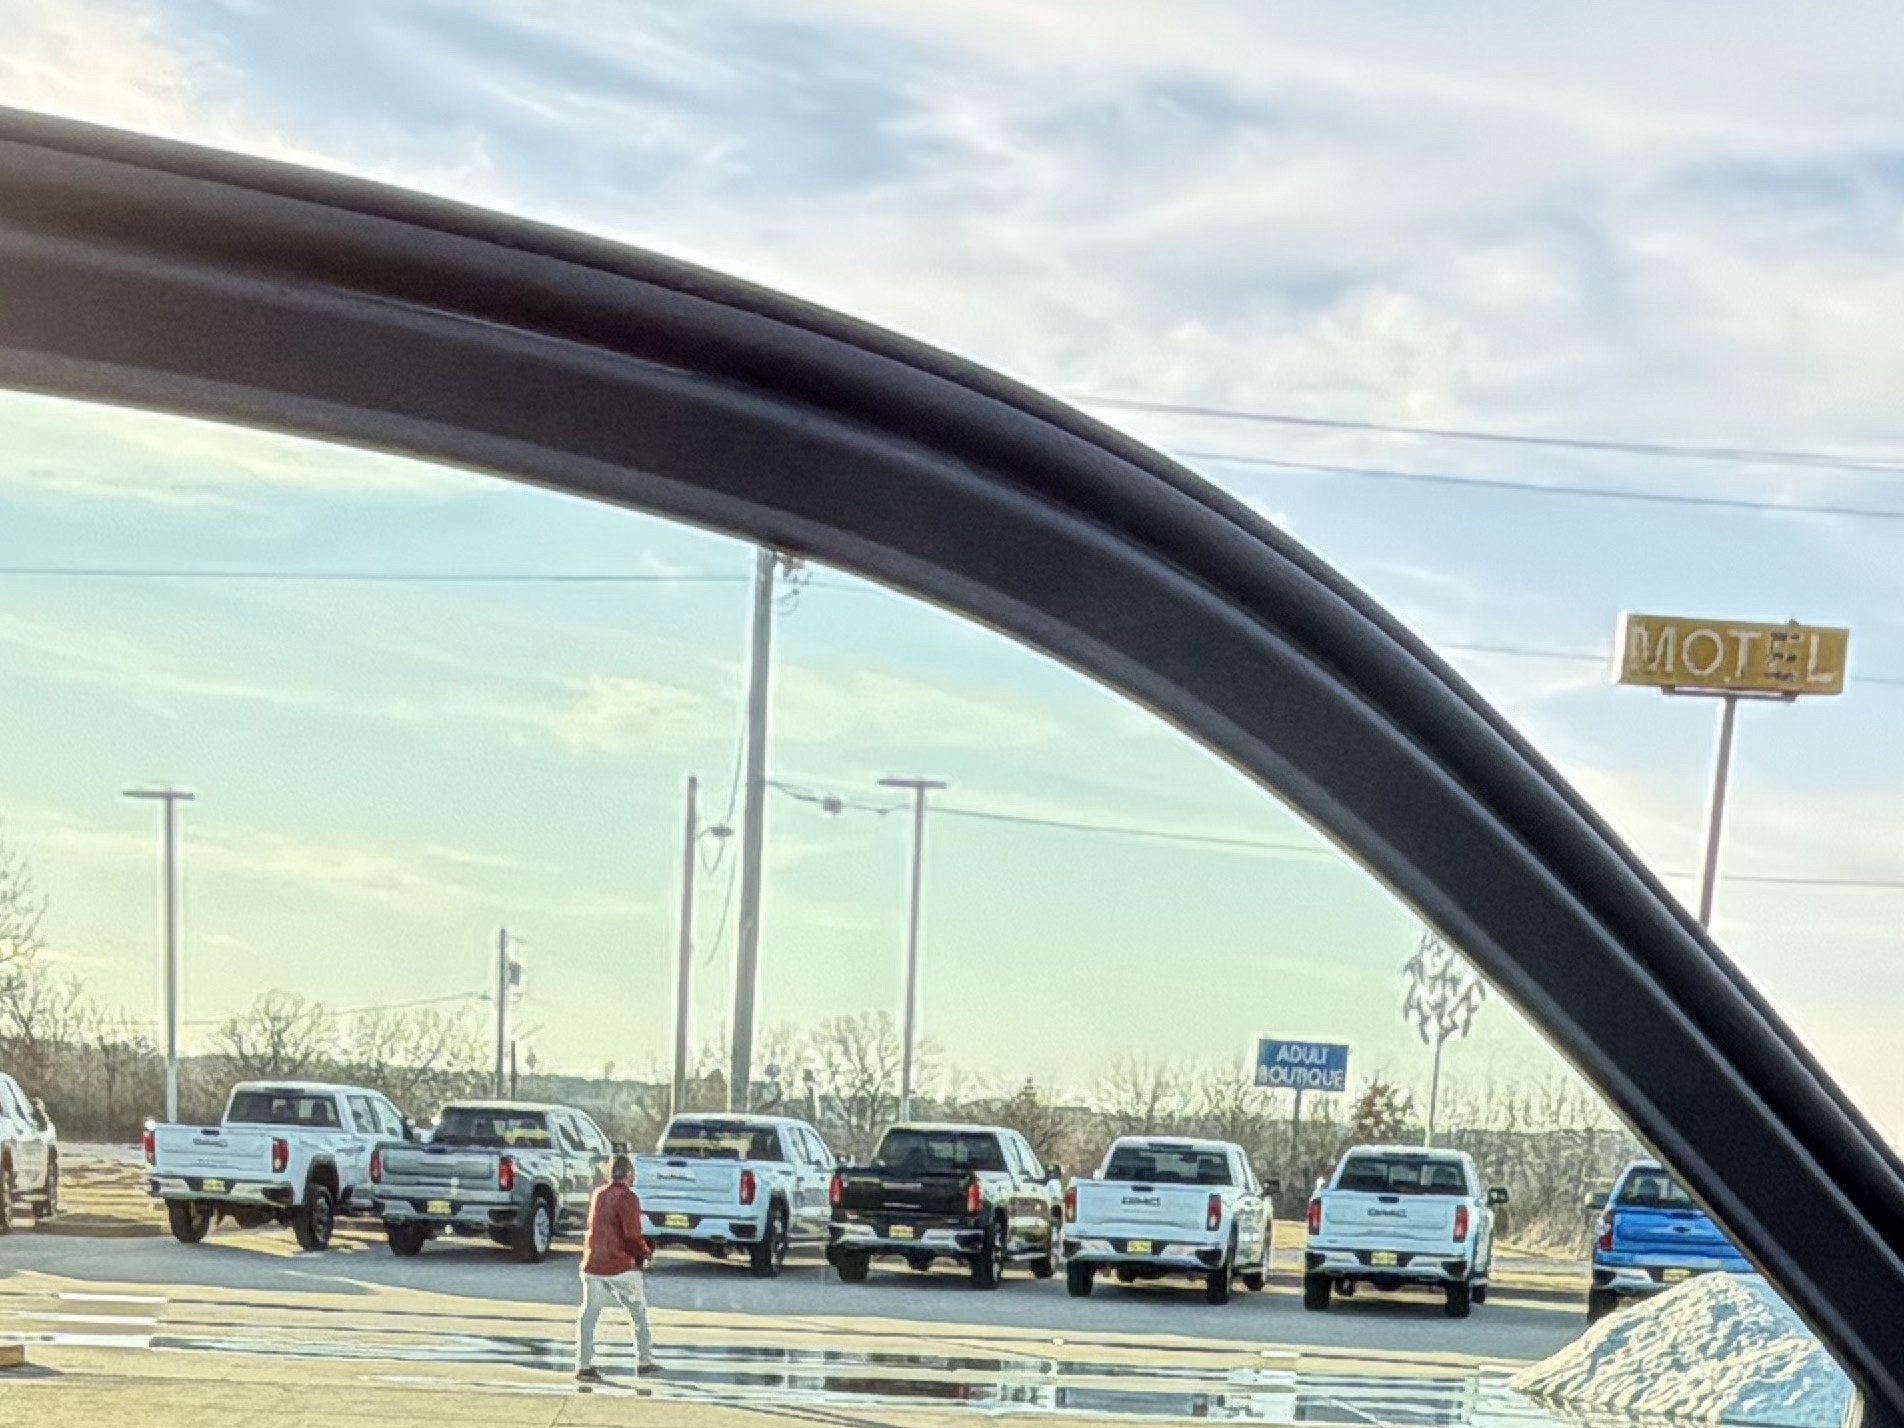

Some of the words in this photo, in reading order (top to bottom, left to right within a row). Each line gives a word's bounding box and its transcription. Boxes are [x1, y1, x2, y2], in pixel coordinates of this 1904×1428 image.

[1630, 621, 1841, 684] MOTEL
[1276, 1044, 1330, 1066] ADULT
[1259, 1064, 1345, 1088] BOUTIQUE
